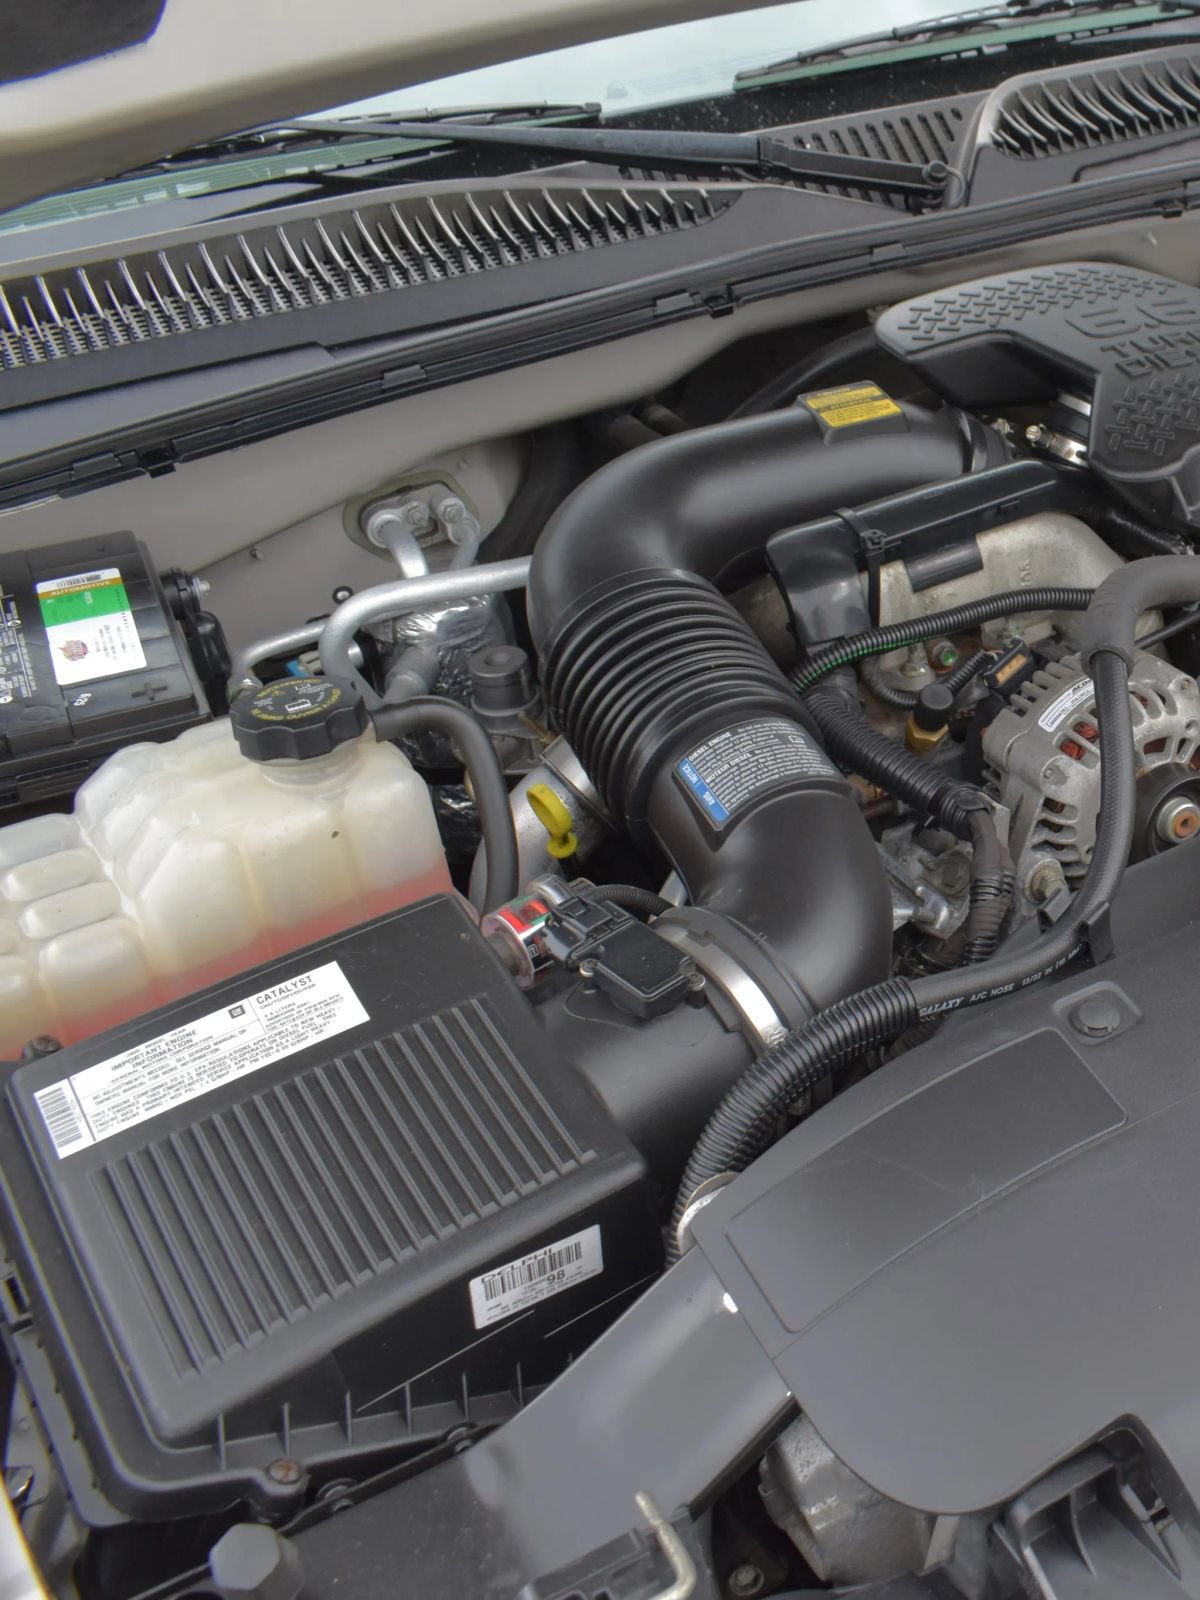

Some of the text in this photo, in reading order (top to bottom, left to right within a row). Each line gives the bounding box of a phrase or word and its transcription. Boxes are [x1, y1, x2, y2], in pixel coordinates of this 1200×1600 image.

[51, 580, 112, 597] AUTOMOTIVE
[687, 731, 733, 762] DIESEL ENGINE
[704, 751, 753, 784] MOTEUR DIESEL
[255, 975, 313, 1004] CATALYST
[918, 996, 965, 1017] GALAXY
[969, 991, 987, 1003] A/C
[990, 982, 1016, 997] HOSE
[111, 1030, 196, 1070] IMPORTANT ENGINE
[132, 1038, 193, 1067] INFORMATION
[481, 1248, 552, 1284] DELPHI
[546, 1269, 566, 1285] 98
